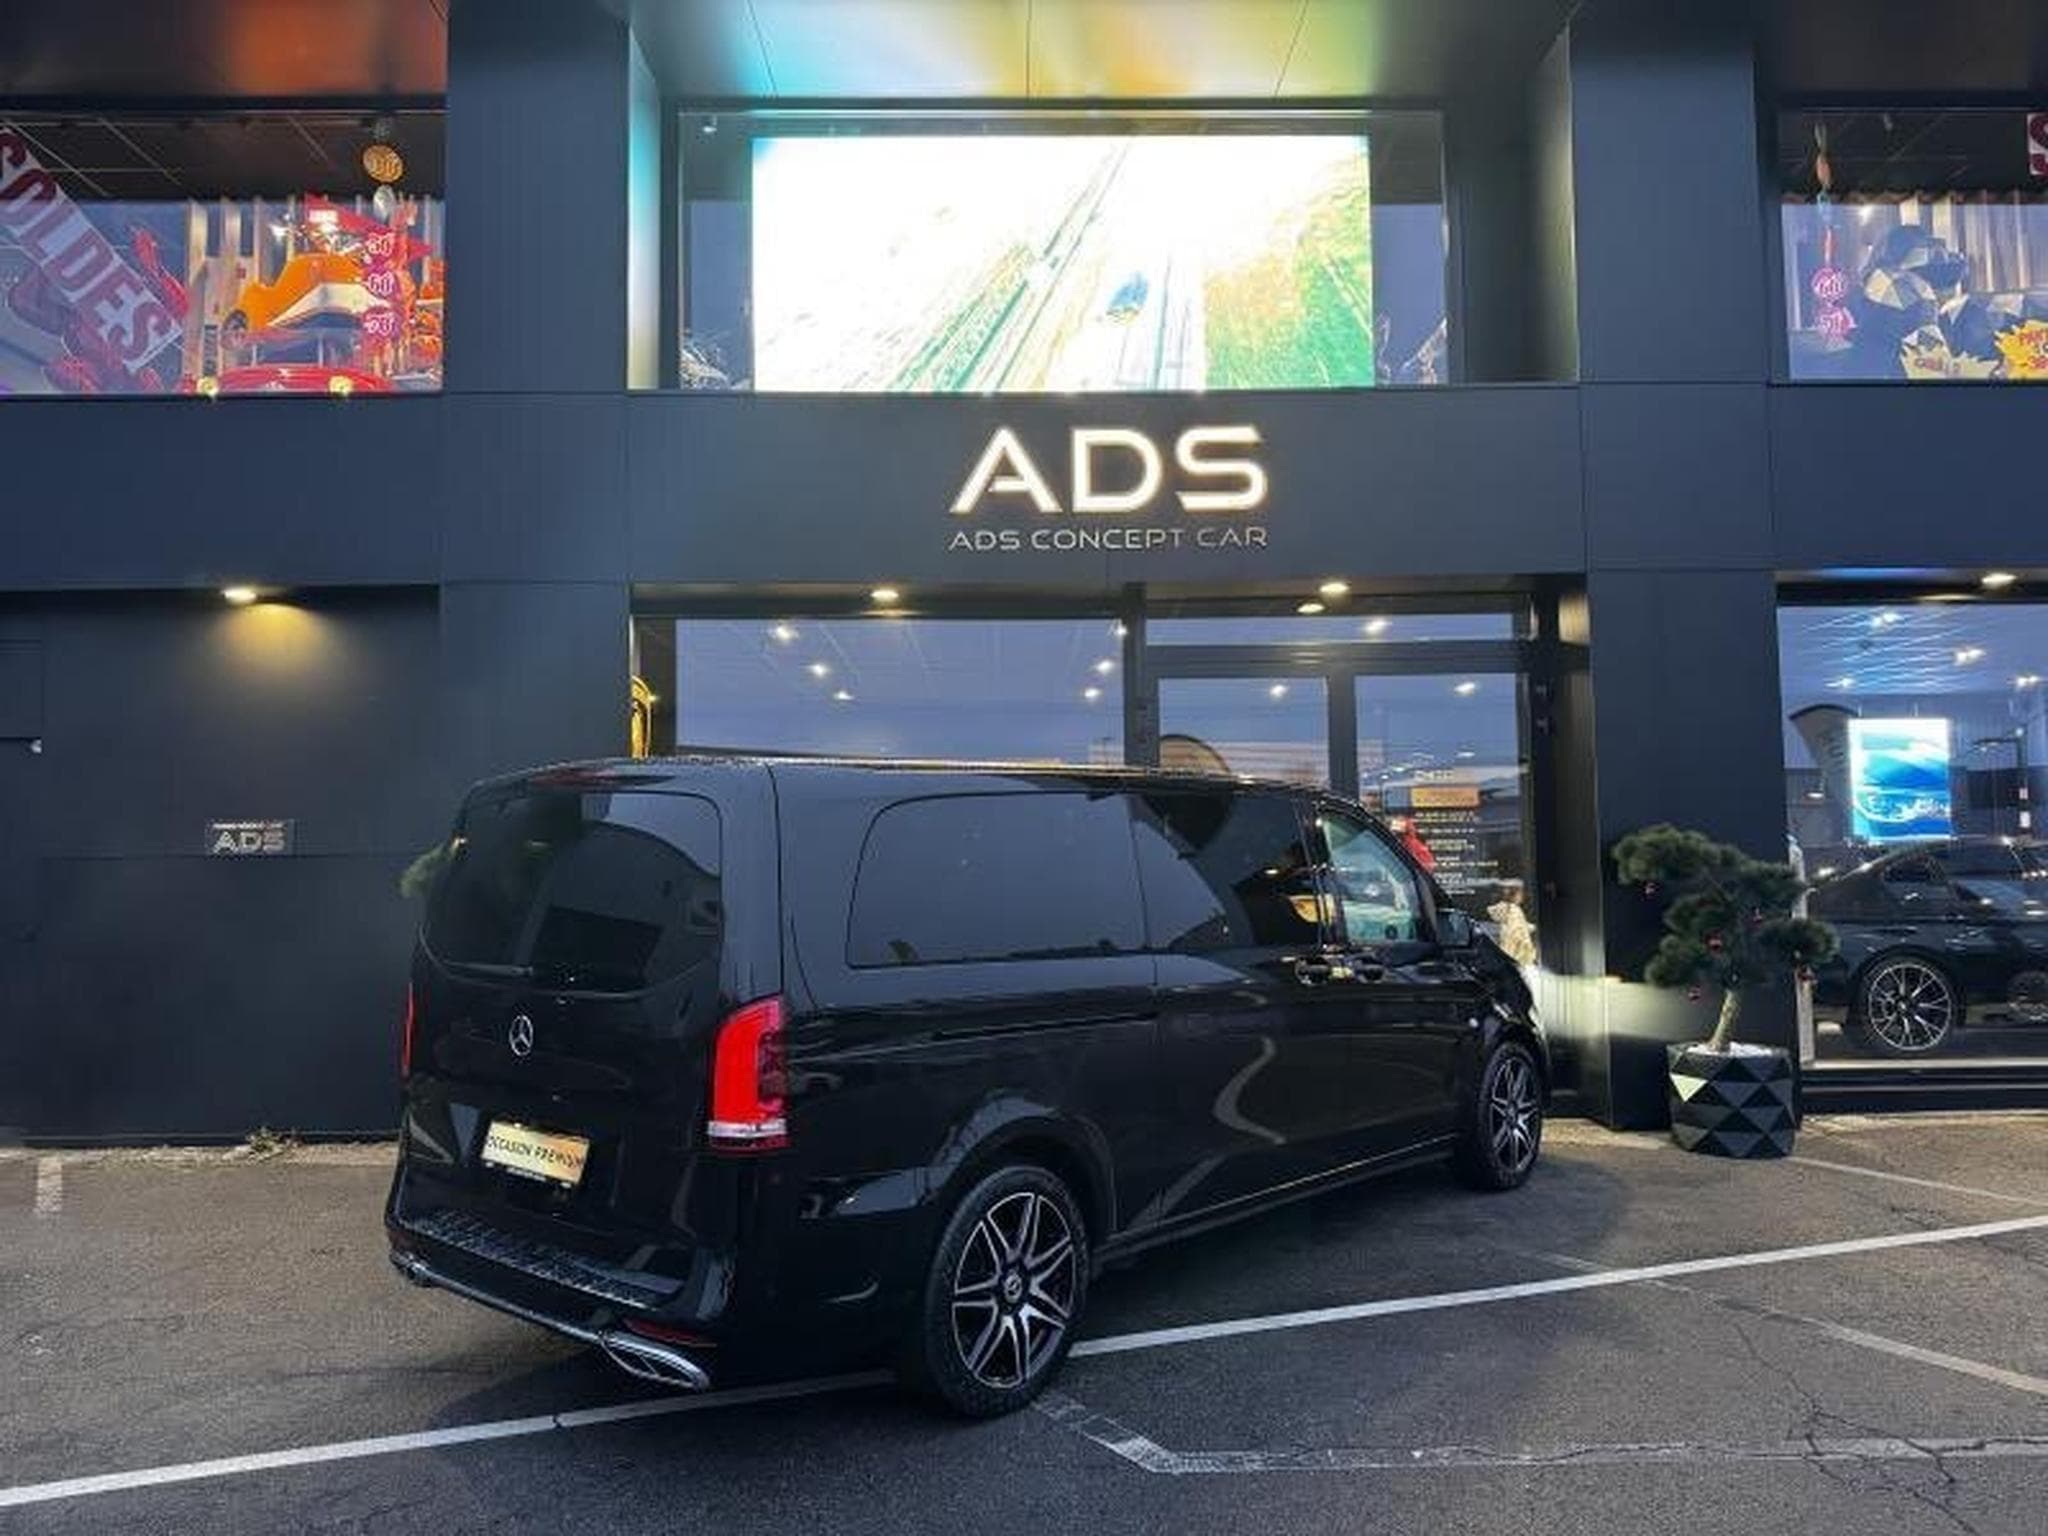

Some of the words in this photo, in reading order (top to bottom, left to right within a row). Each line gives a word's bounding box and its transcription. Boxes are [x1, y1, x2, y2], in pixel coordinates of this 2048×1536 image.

[949, 425, 1268, 513] ADS
[949, 530, 1021, 551] ADS
[1031, 528, 1185, 550] CONCEPT
[1196, 526, 1268, 548] CAR
[212, 831, 285, 854] ADS
